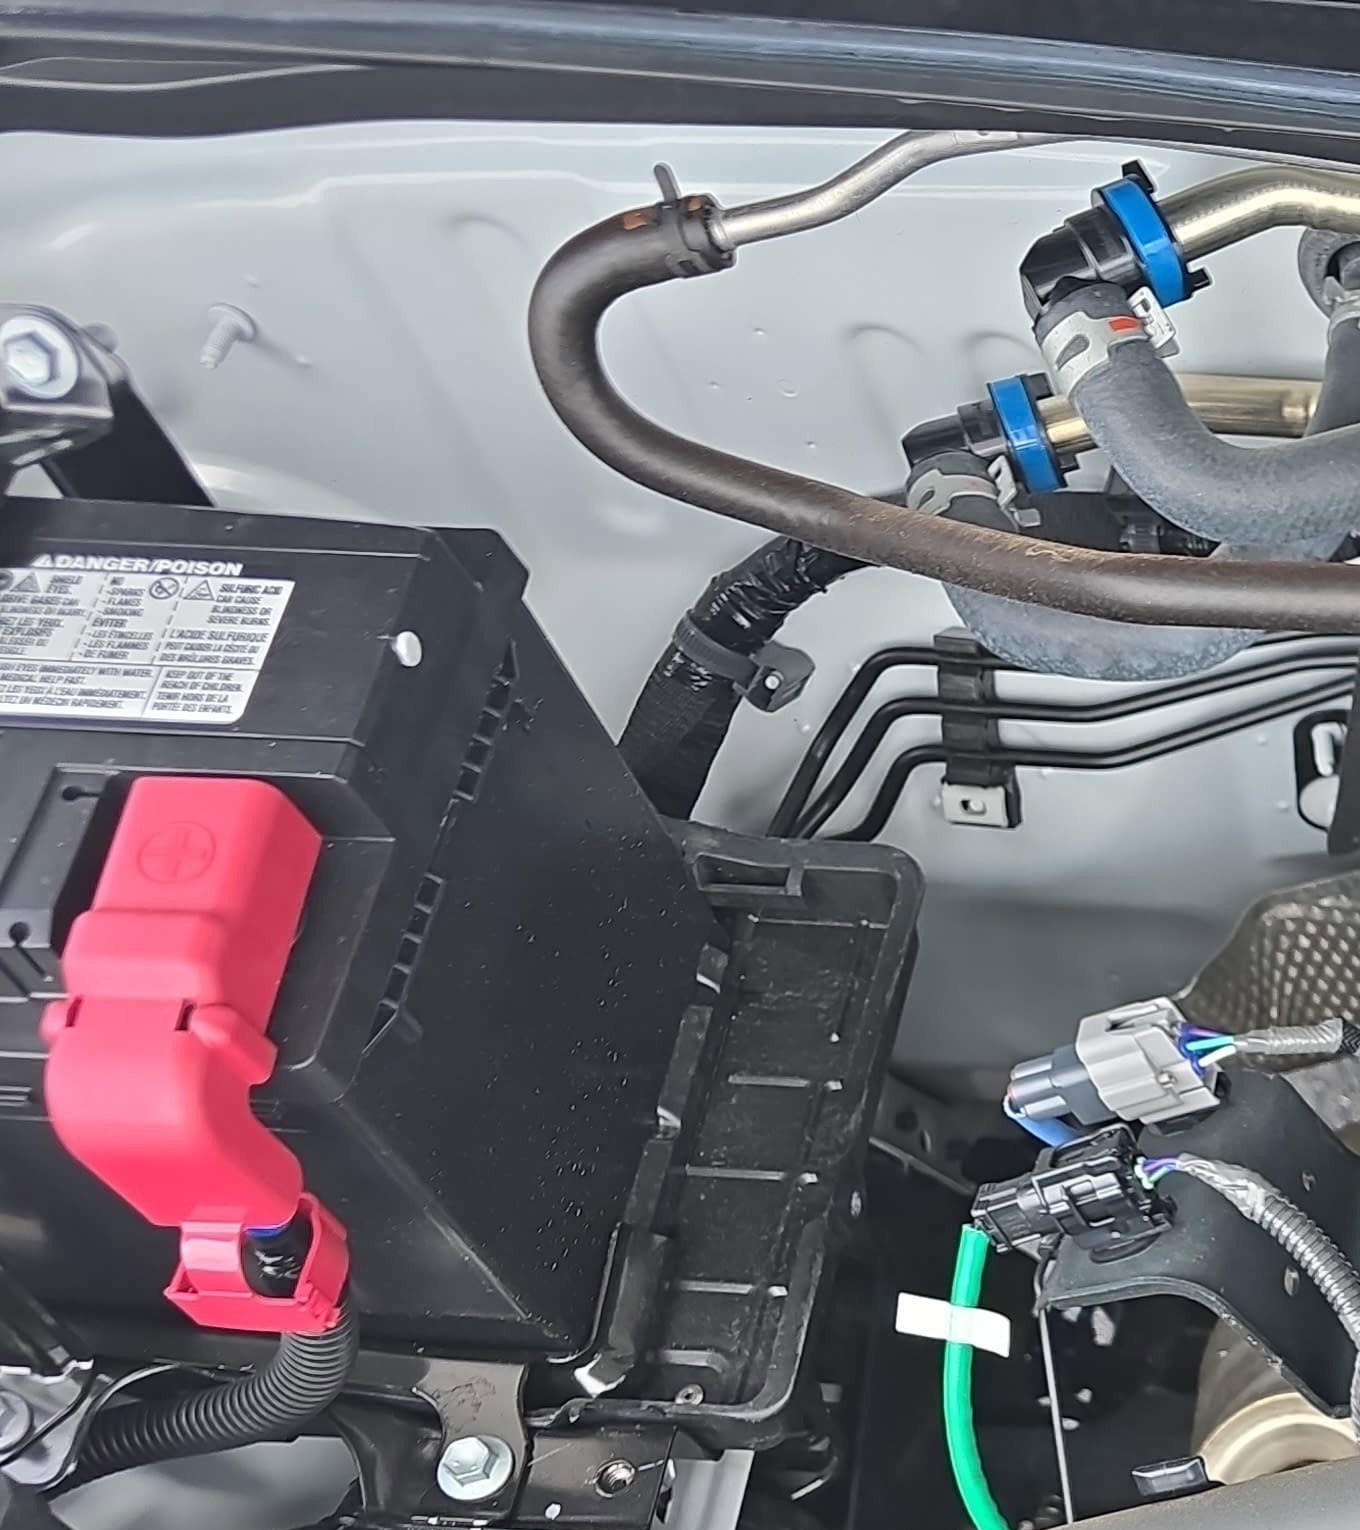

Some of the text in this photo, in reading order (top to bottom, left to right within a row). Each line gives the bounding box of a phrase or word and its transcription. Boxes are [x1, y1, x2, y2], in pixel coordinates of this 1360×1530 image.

[55, 555, 243, 576] DANGER/POISON
[219, 583, 261, 594] SULFURIC
[234, 595, 263, 604] CAUSE
[207, 629, 270, 642] SULFURIQUE
